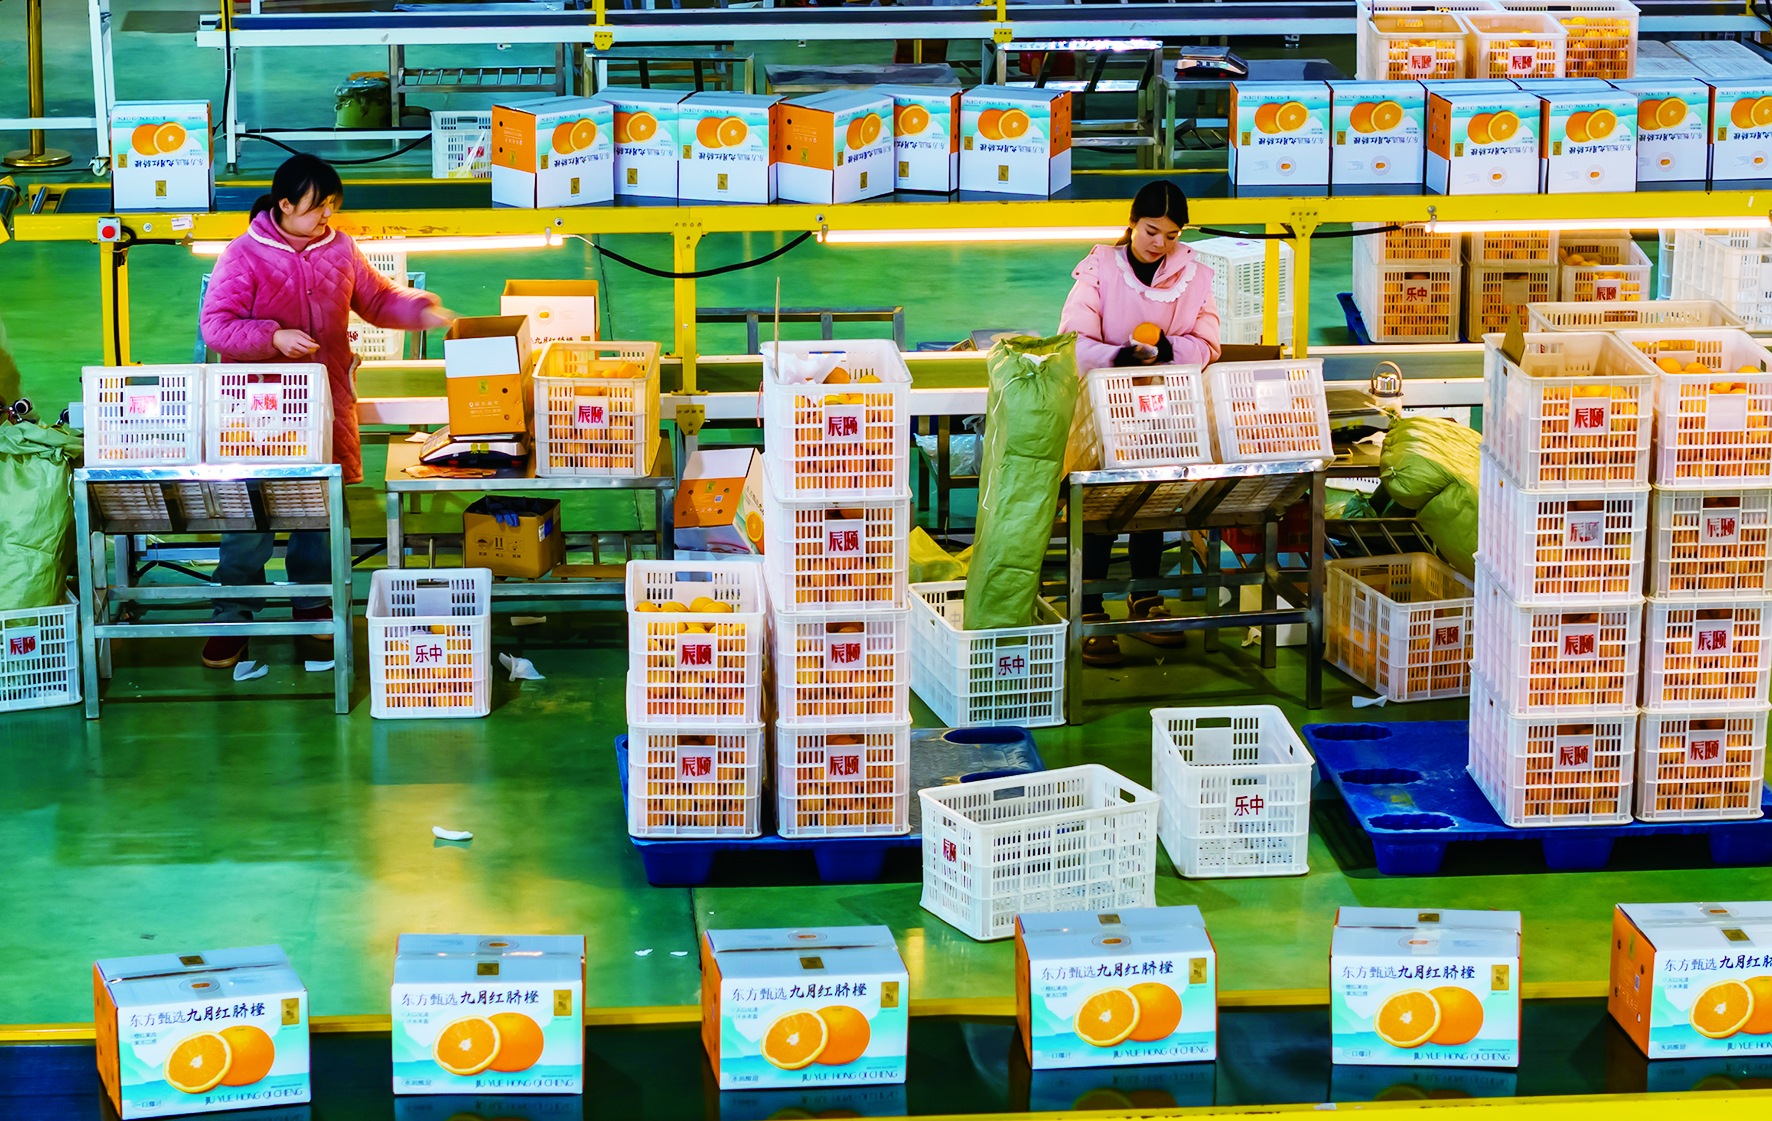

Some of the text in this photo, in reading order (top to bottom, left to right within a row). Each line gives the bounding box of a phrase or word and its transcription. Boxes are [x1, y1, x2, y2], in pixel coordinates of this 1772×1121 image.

[415, 644, 443, 664] 乐中
[998, 655, 1025, 676] 乐中
[1234, 794, 1264, 817] 乐中
[1113, 1046, 1208, 1059] JIU YUE HONG QI CHENG
[1727, 1043, 1737, 1051] JIU
[1414, 1053, 1423, 1061] JIU
[1444, 1052, 1469, 1060] HONG
[1470, 1052, 1480, 1062] QI
[1481, 1052, 1510, 1061] CHENG
[476, 1078, 574, 1089] JIU YUE HONG QI CHENG
[802, 1071, 898, 1083] JIU YUE HONG QI CHENG
[205, 1088, 303, 1106] JIU YUE HONG QI CHENG
